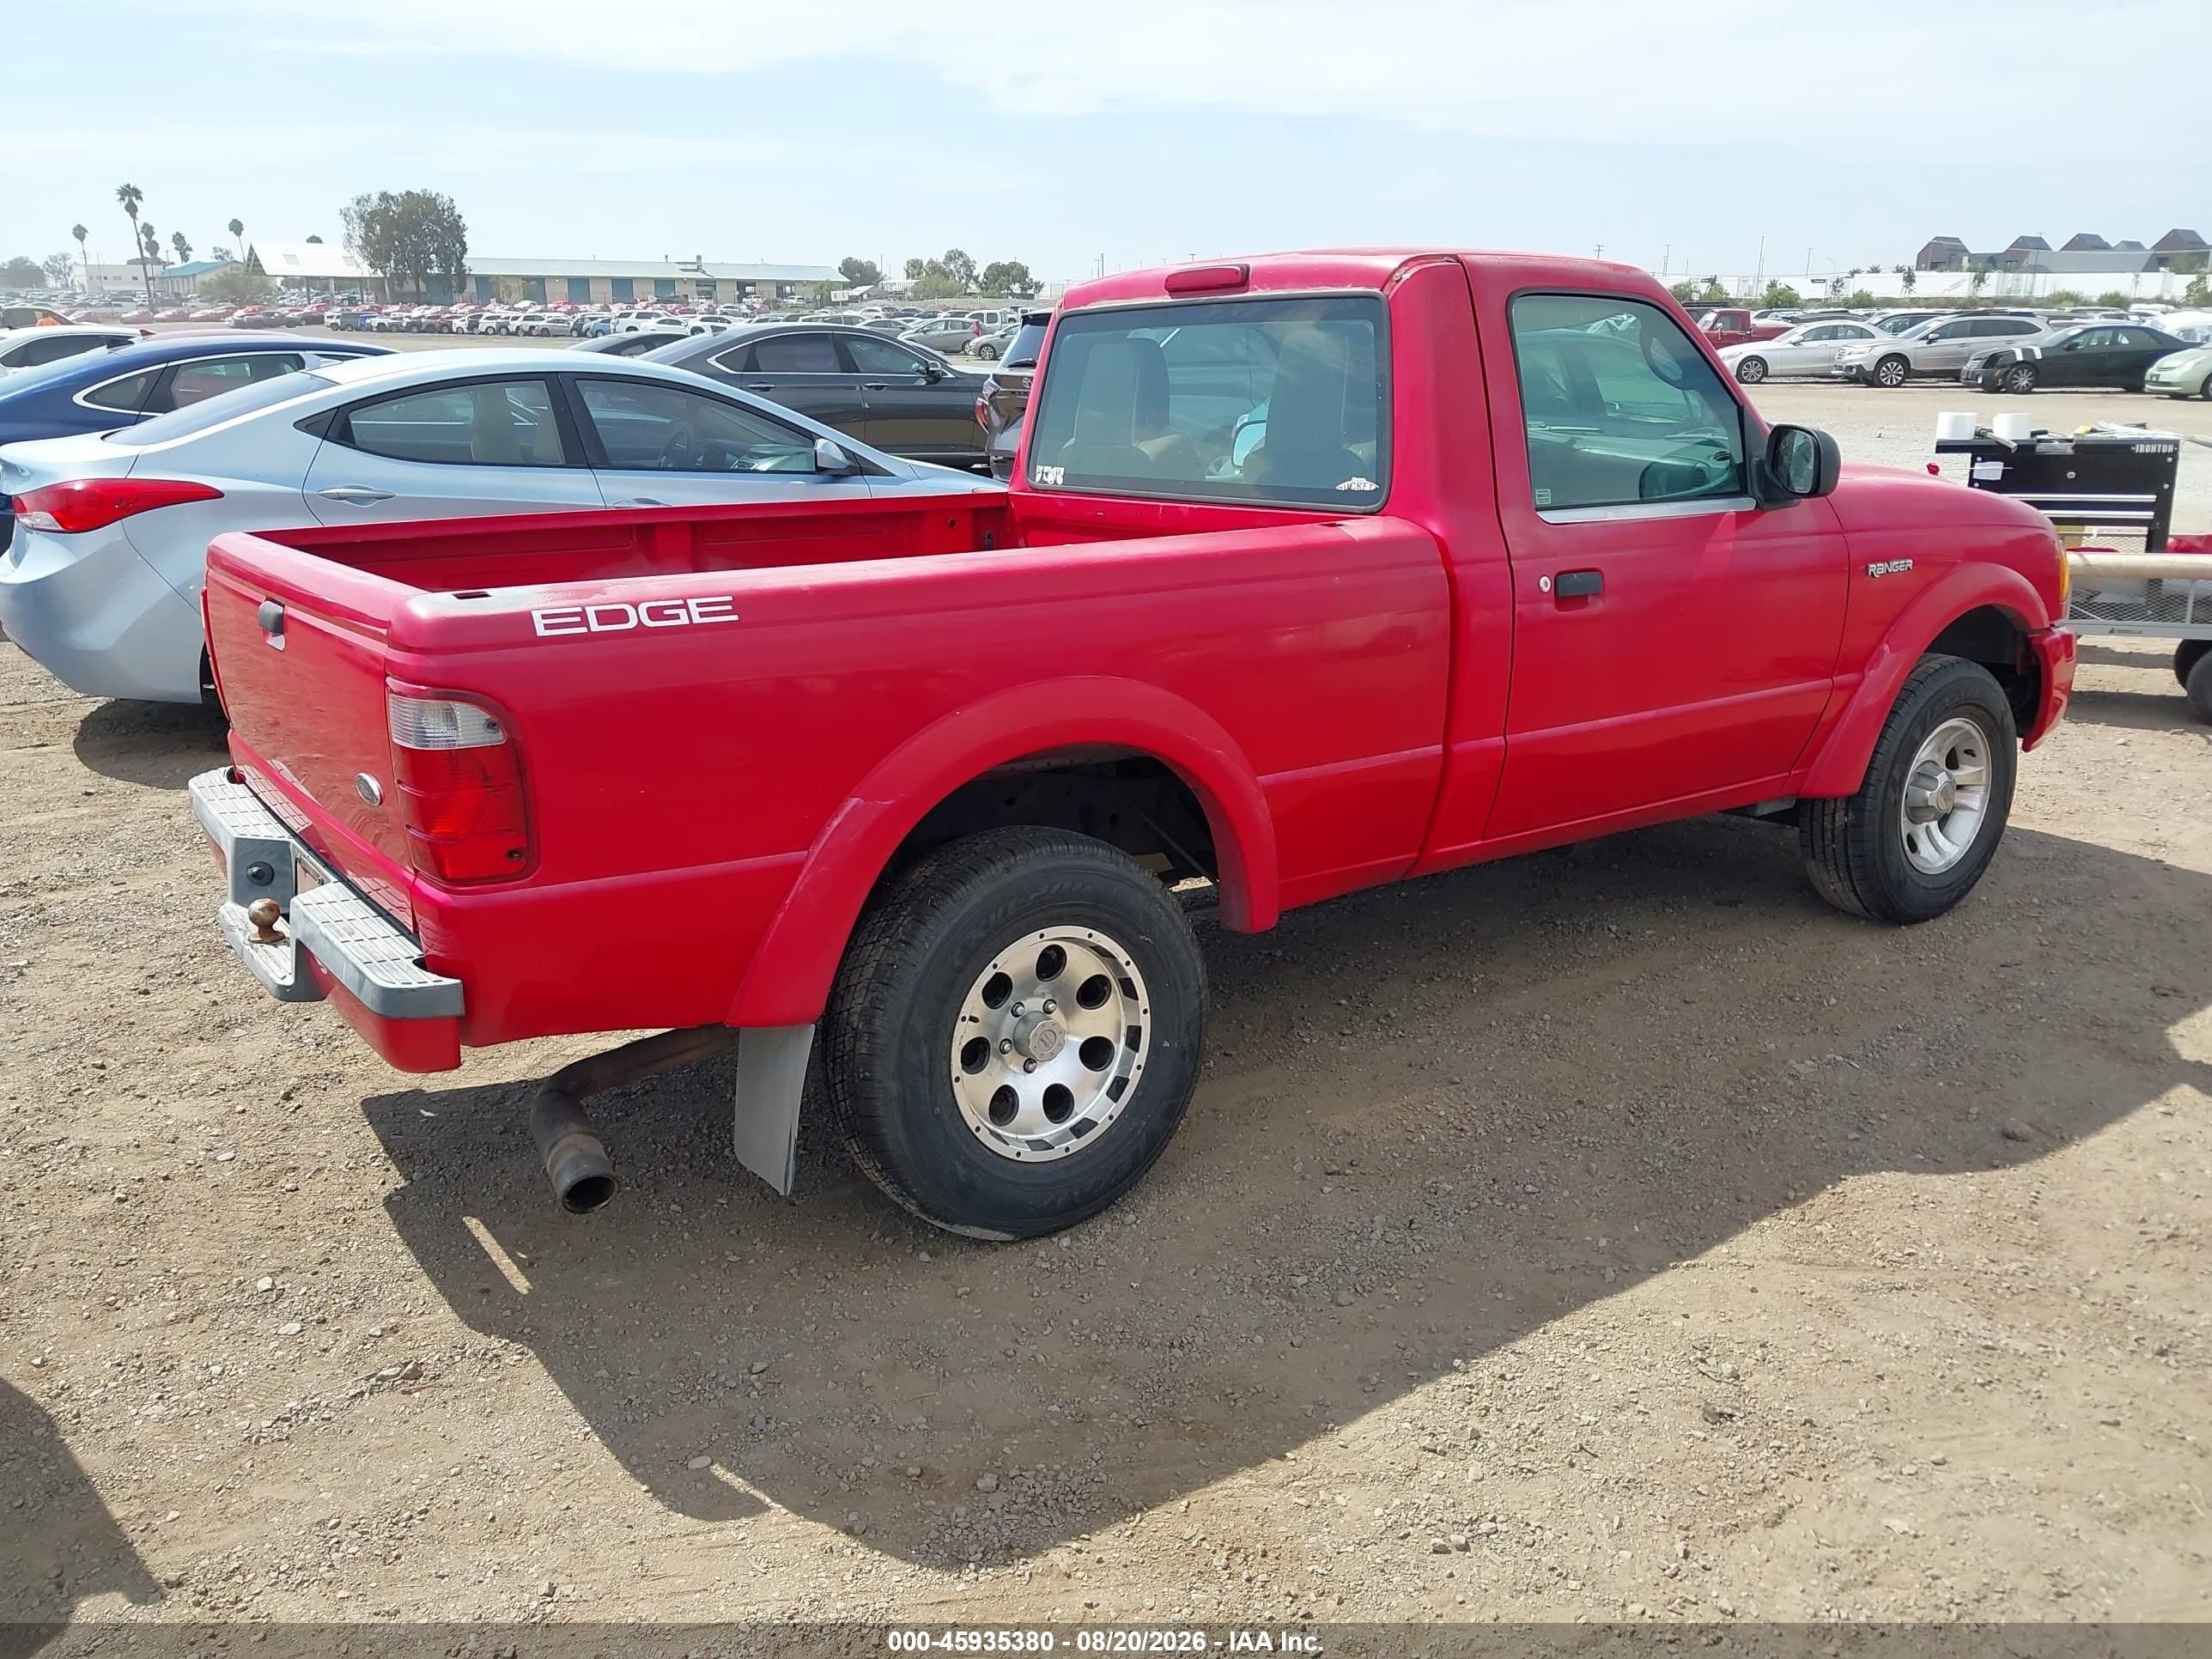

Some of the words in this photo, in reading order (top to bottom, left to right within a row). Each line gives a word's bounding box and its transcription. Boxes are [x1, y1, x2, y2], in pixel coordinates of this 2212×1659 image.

[2135, 443, 2174, 453] IRONTON
[1868, 559, 1913, 578] RANGER
[531, 596, 739, 637] EDGE
